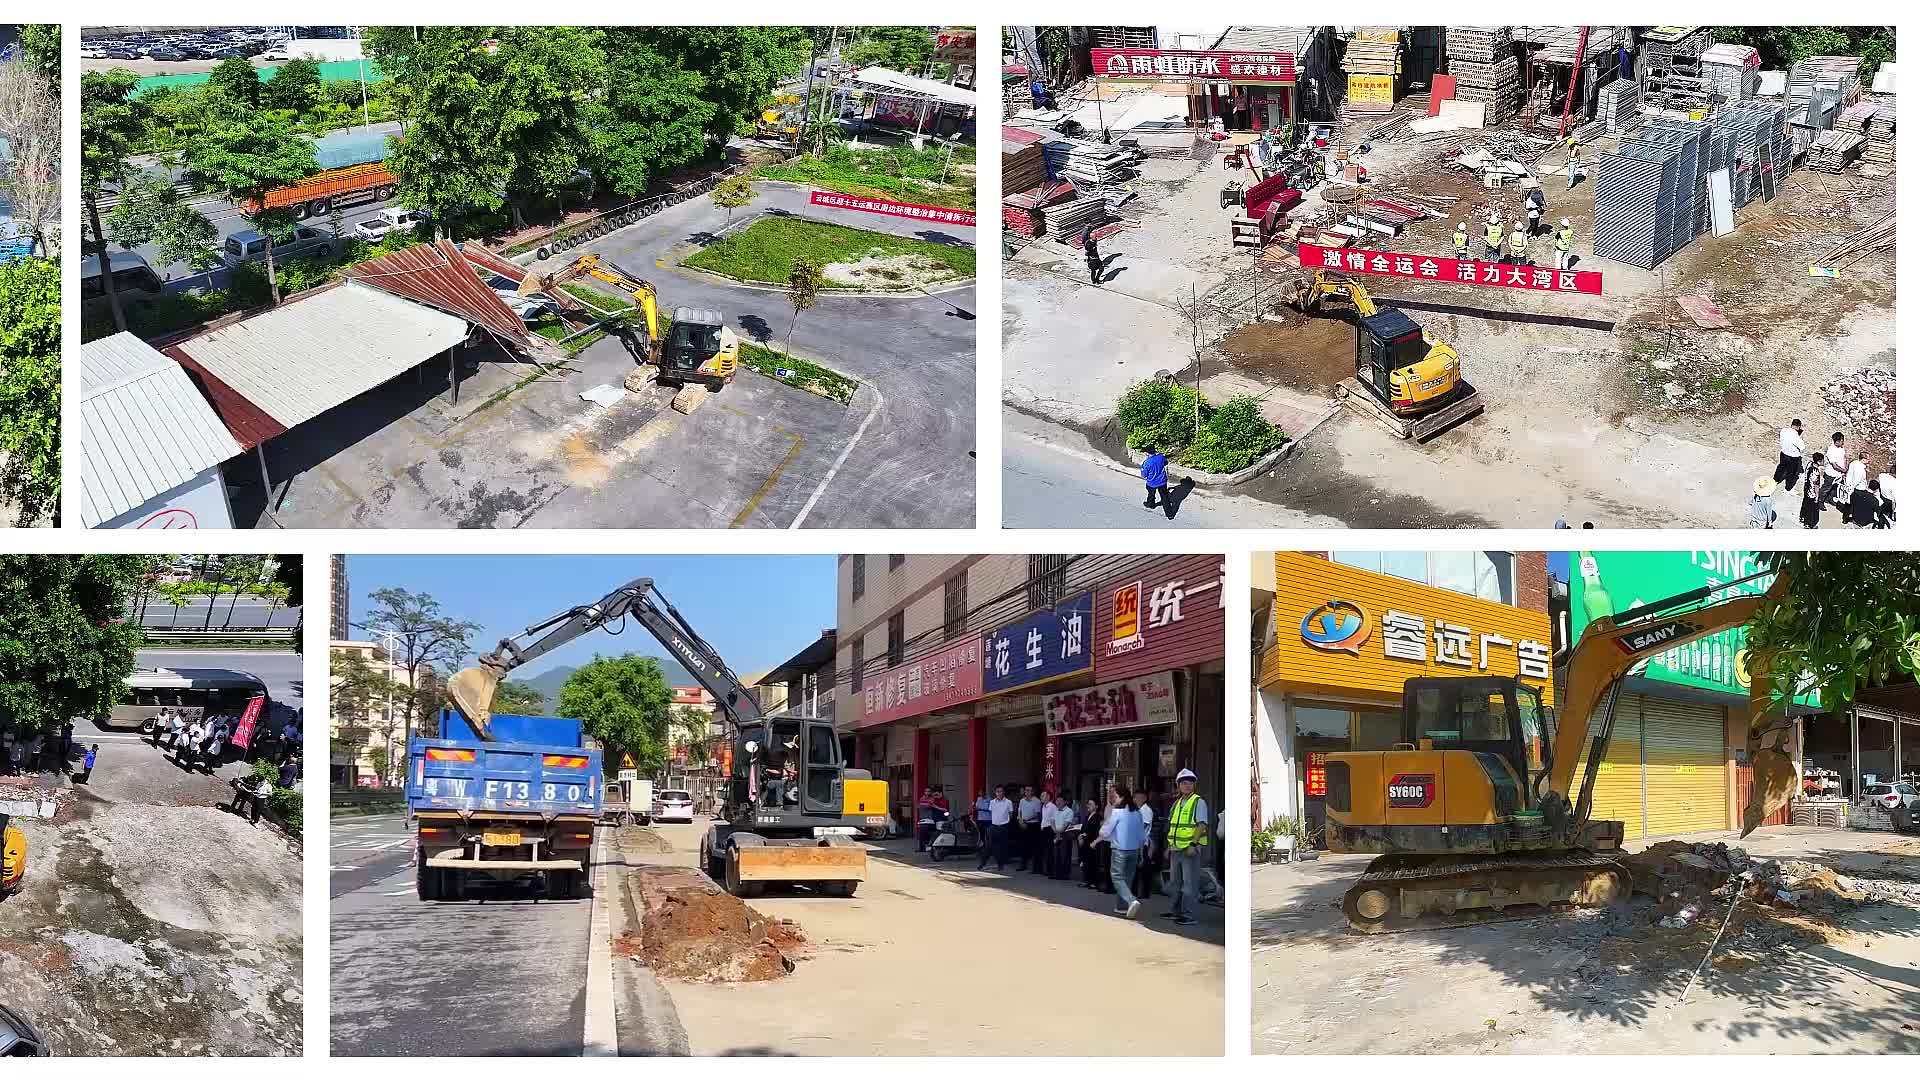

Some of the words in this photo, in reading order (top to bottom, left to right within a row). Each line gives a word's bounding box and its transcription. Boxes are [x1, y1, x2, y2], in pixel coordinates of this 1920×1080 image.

[1131, 55, 1222, 75] 雨虹防水
[1323, 249, 1440, 278] 激情全运会
[1457, 263, 1577, 290] 活力大湾区
[1149, 563, 1225, 629] 统一
[995, 612, 1083, 678] 花生油
[1106, 633, 1142, 655] Monarch
[1383, 609, 1551, 679] 睿远广告
[1634, 624, 1677, 650] SANY
[1389, 785, 1423, 798] SY60C
